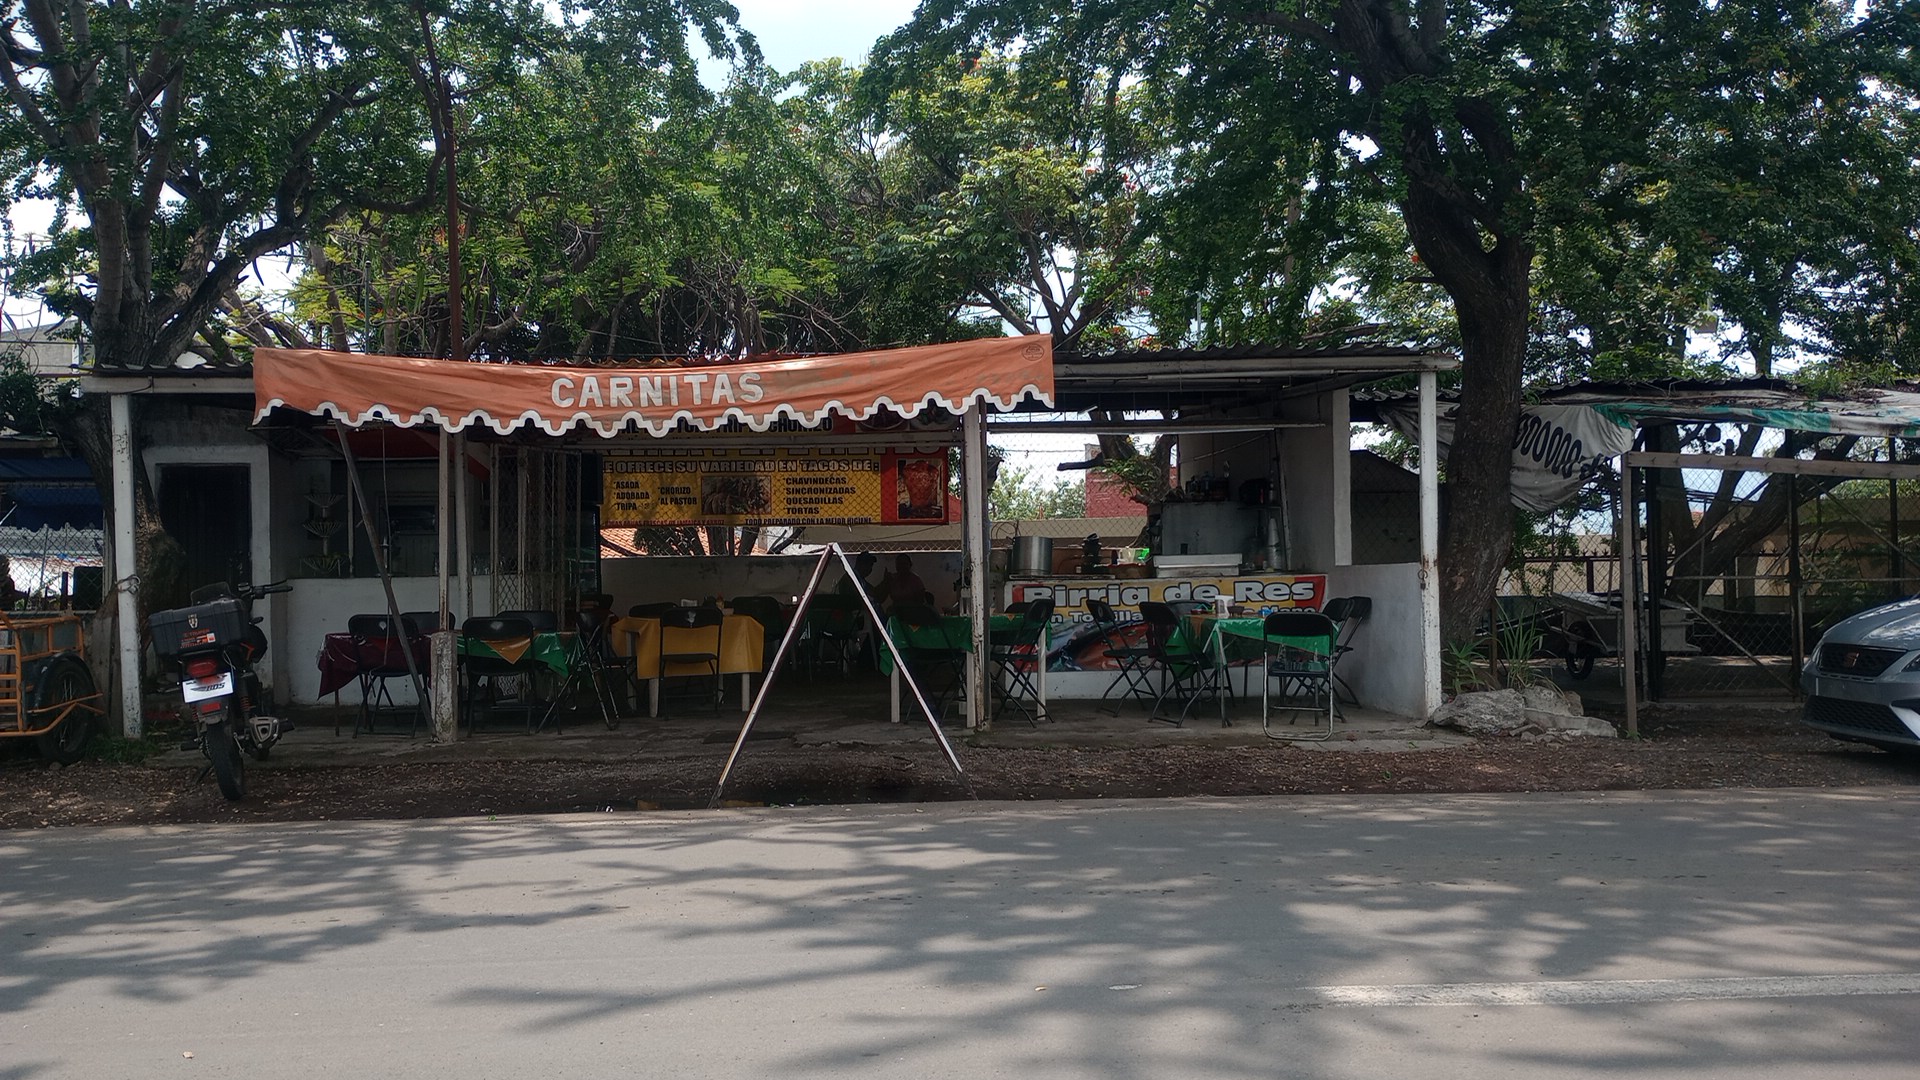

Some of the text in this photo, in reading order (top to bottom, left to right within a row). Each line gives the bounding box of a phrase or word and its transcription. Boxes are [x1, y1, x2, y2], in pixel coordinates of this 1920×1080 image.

[551, 372, 764, 408] CARNITAS
[616, 461, 673, 474] OFRECE
[675, 460, 698, 473] SU
[699, 460, 775, 473] VARIEDAD
[778, 459, 798, 472] EN
[799, 459, 850, 472] TACOS
[670, 497, 697, 505] PASTOR
[1023, 580, 1314, 607] Birria de Res
